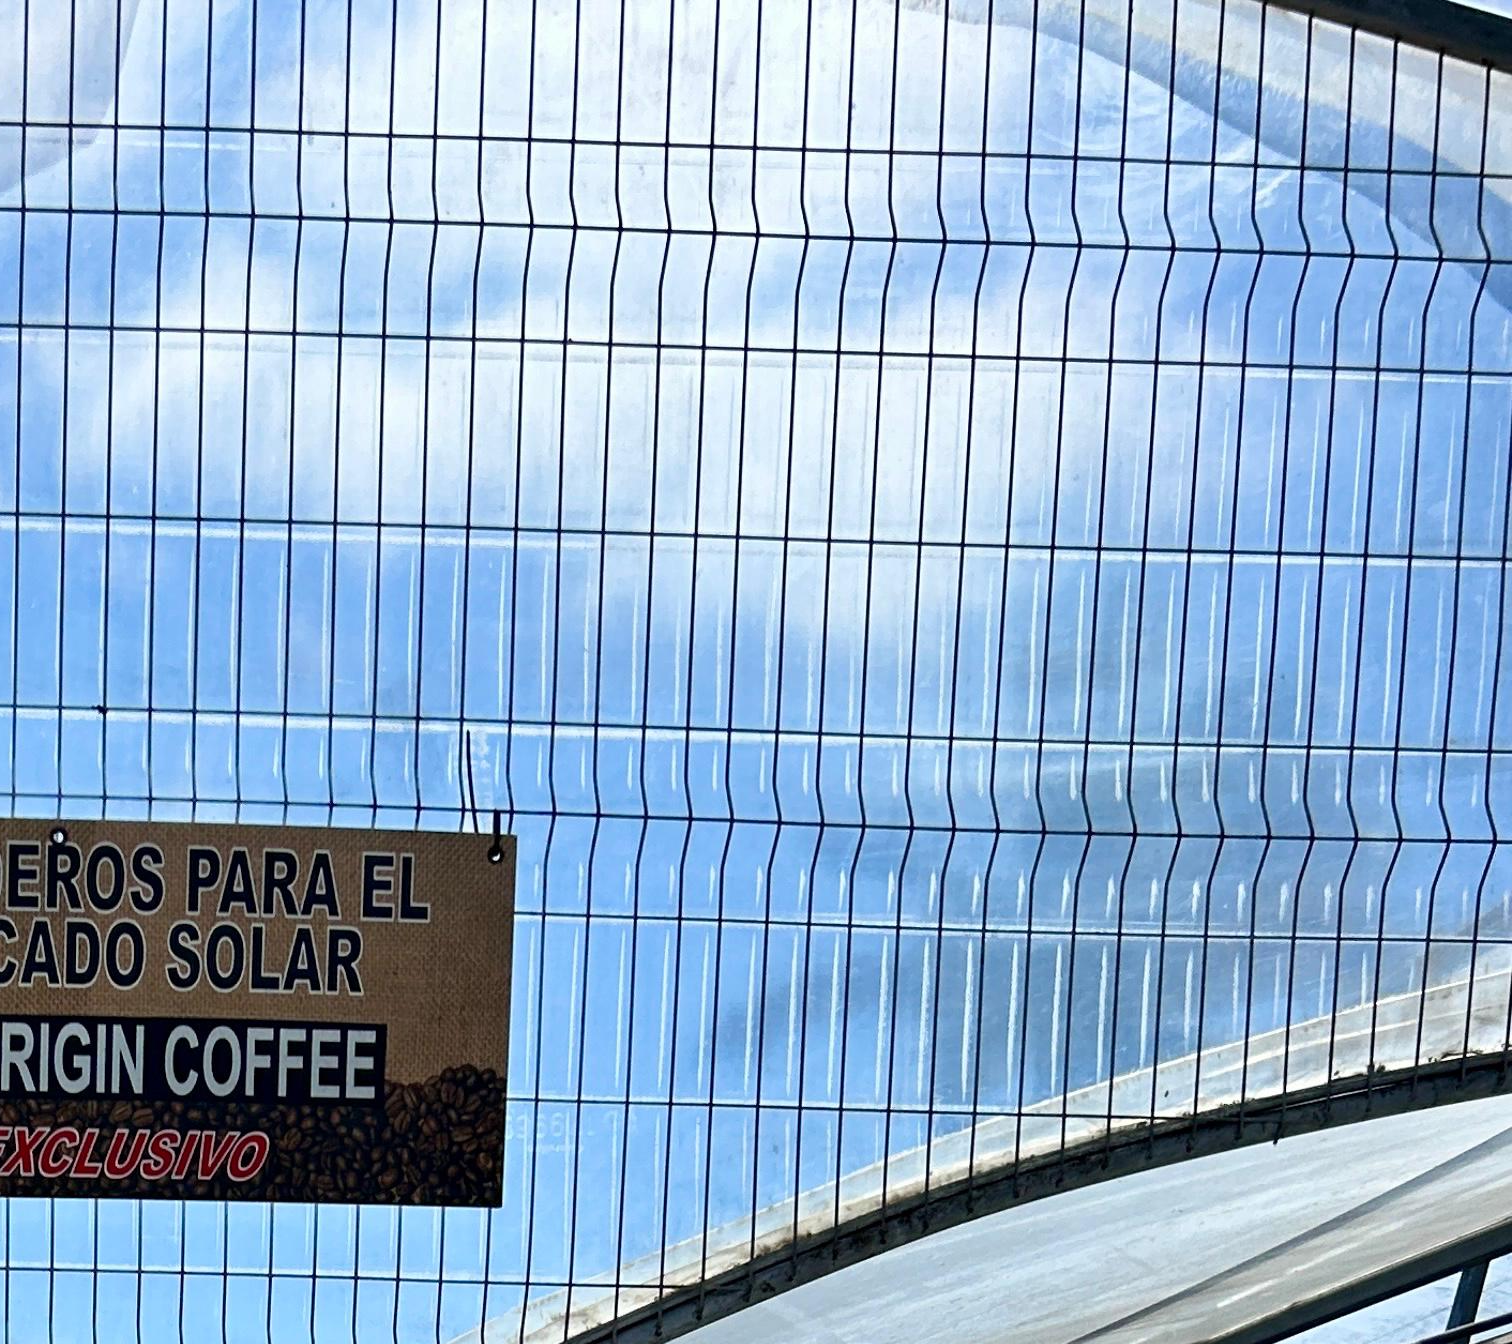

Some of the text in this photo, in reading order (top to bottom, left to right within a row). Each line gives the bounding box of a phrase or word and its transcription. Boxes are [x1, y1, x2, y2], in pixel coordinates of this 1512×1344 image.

[187, 846, 340, 918] PARA
[362, 851, 430, 922] EL
[165, 921, 363, 995] SOLAR
[164, 1025, 376, 1098] COFFEE
